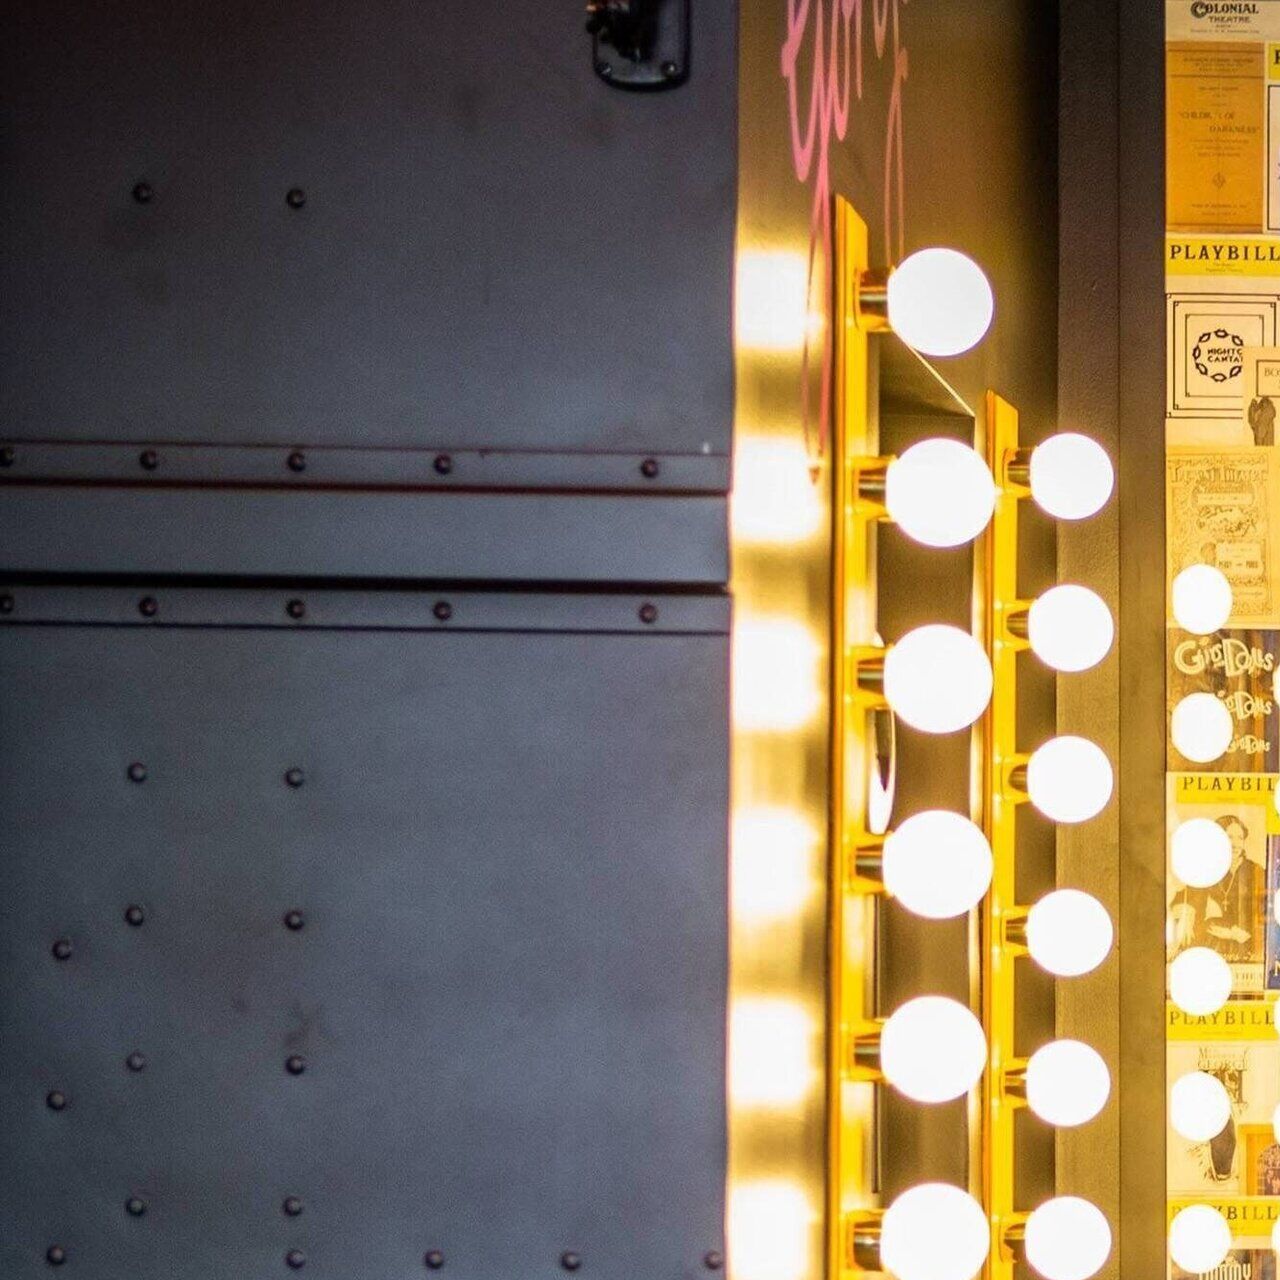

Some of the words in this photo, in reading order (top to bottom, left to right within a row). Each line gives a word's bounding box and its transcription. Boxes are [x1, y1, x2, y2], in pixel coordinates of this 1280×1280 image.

[1191, 1, 1258, 19] COLONIAL
[1170, 245, 1280, 261] PLAYBILL
[1169, 1010, 1275, 1025] PLAYBILL
